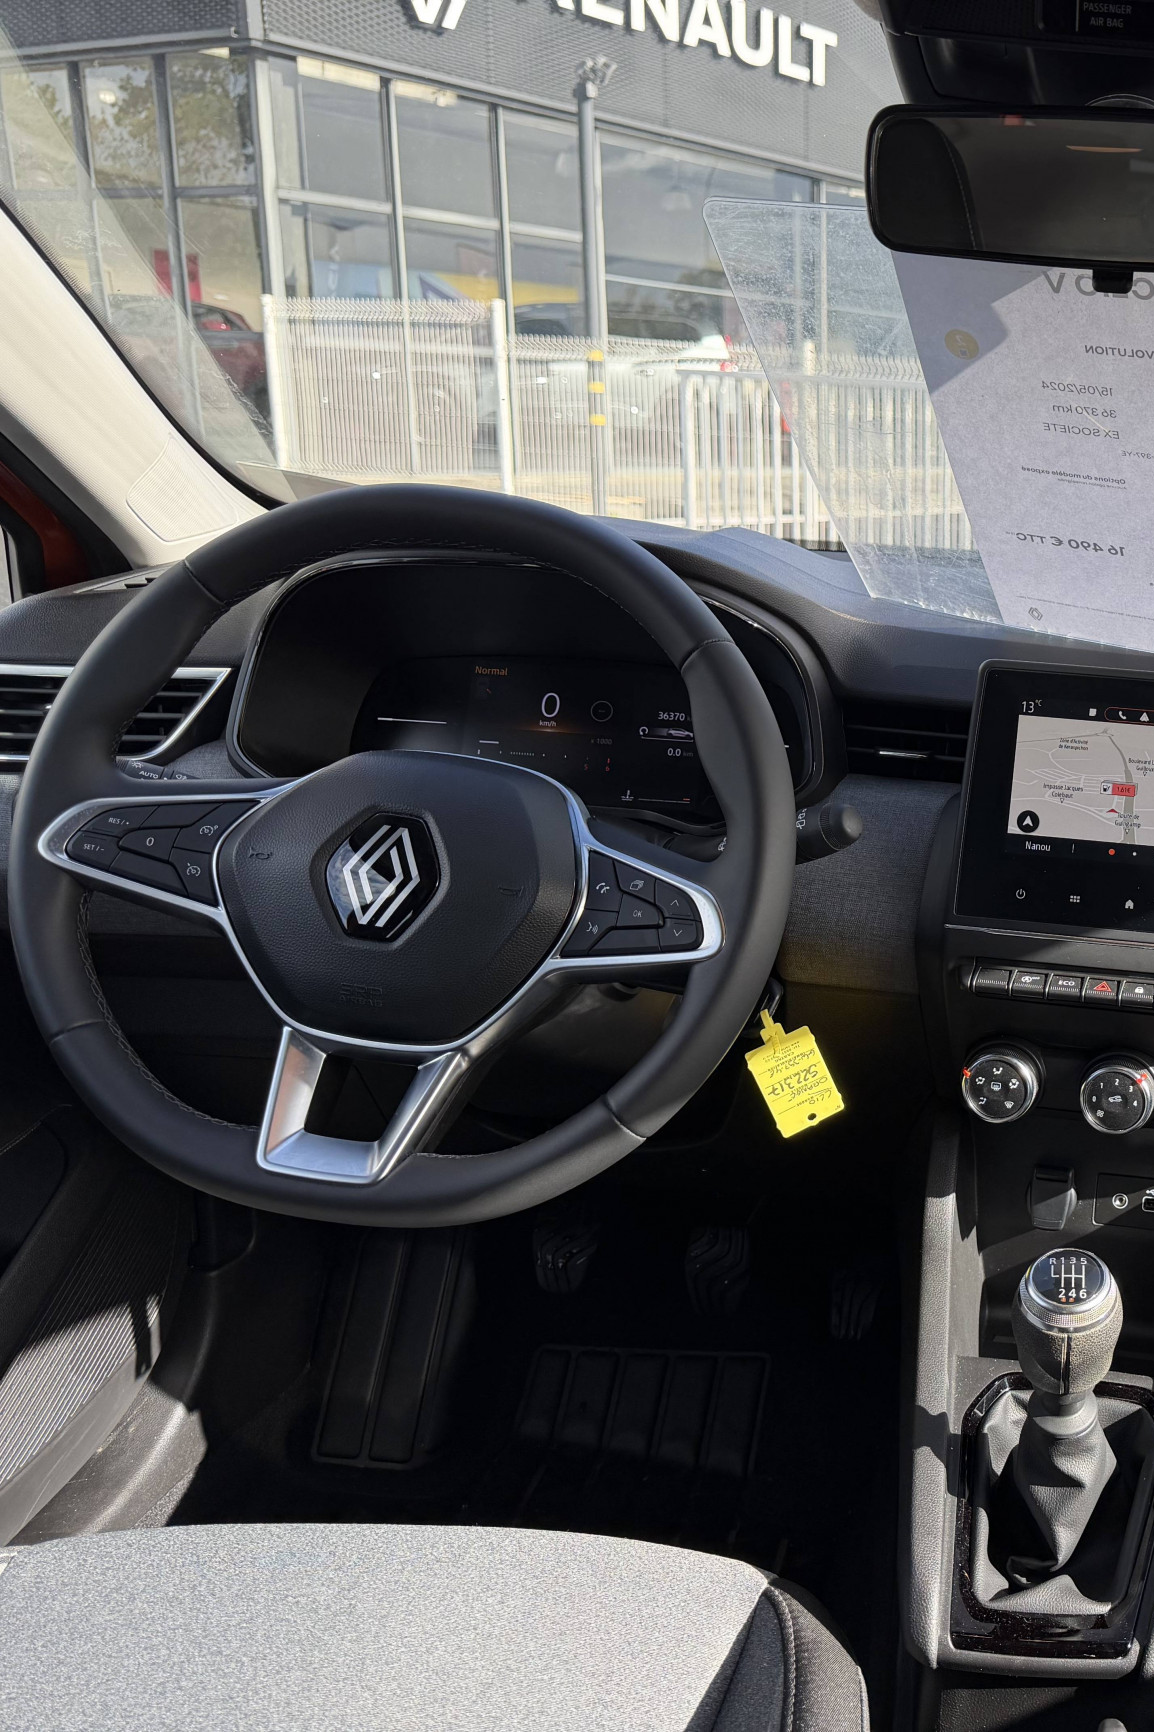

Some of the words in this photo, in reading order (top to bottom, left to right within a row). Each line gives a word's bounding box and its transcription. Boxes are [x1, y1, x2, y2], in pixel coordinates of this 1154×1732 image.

[1083, 2, 1132, 14] PASSENGER
[1089, 17, 1104, 27] AIR
[1106, 17, 1124, 28] BAG
[475, 665, 508, 677] Normal
[541, 692, 561, 719] 0
[657, 711, 686, 722] 36370
[539, 719, 557, 728] km/h
[667, 748, 681, 757] 0.0
[1025, 841, 1051, 853] Nanou
[632, 910, 643, 918] OK
[1058, 979, 1075, 987] ECO
[1049, 1257, 1057, 1265] R
[1069, 1256, 1077, 1265] 3
[1080, 1257, 1088, 1265] 5
[1058, 1288, 1066, 1298] 2
[1068, 1288, 1077, 1298] 4
[1079, 1288, 1087, 1299] 6
